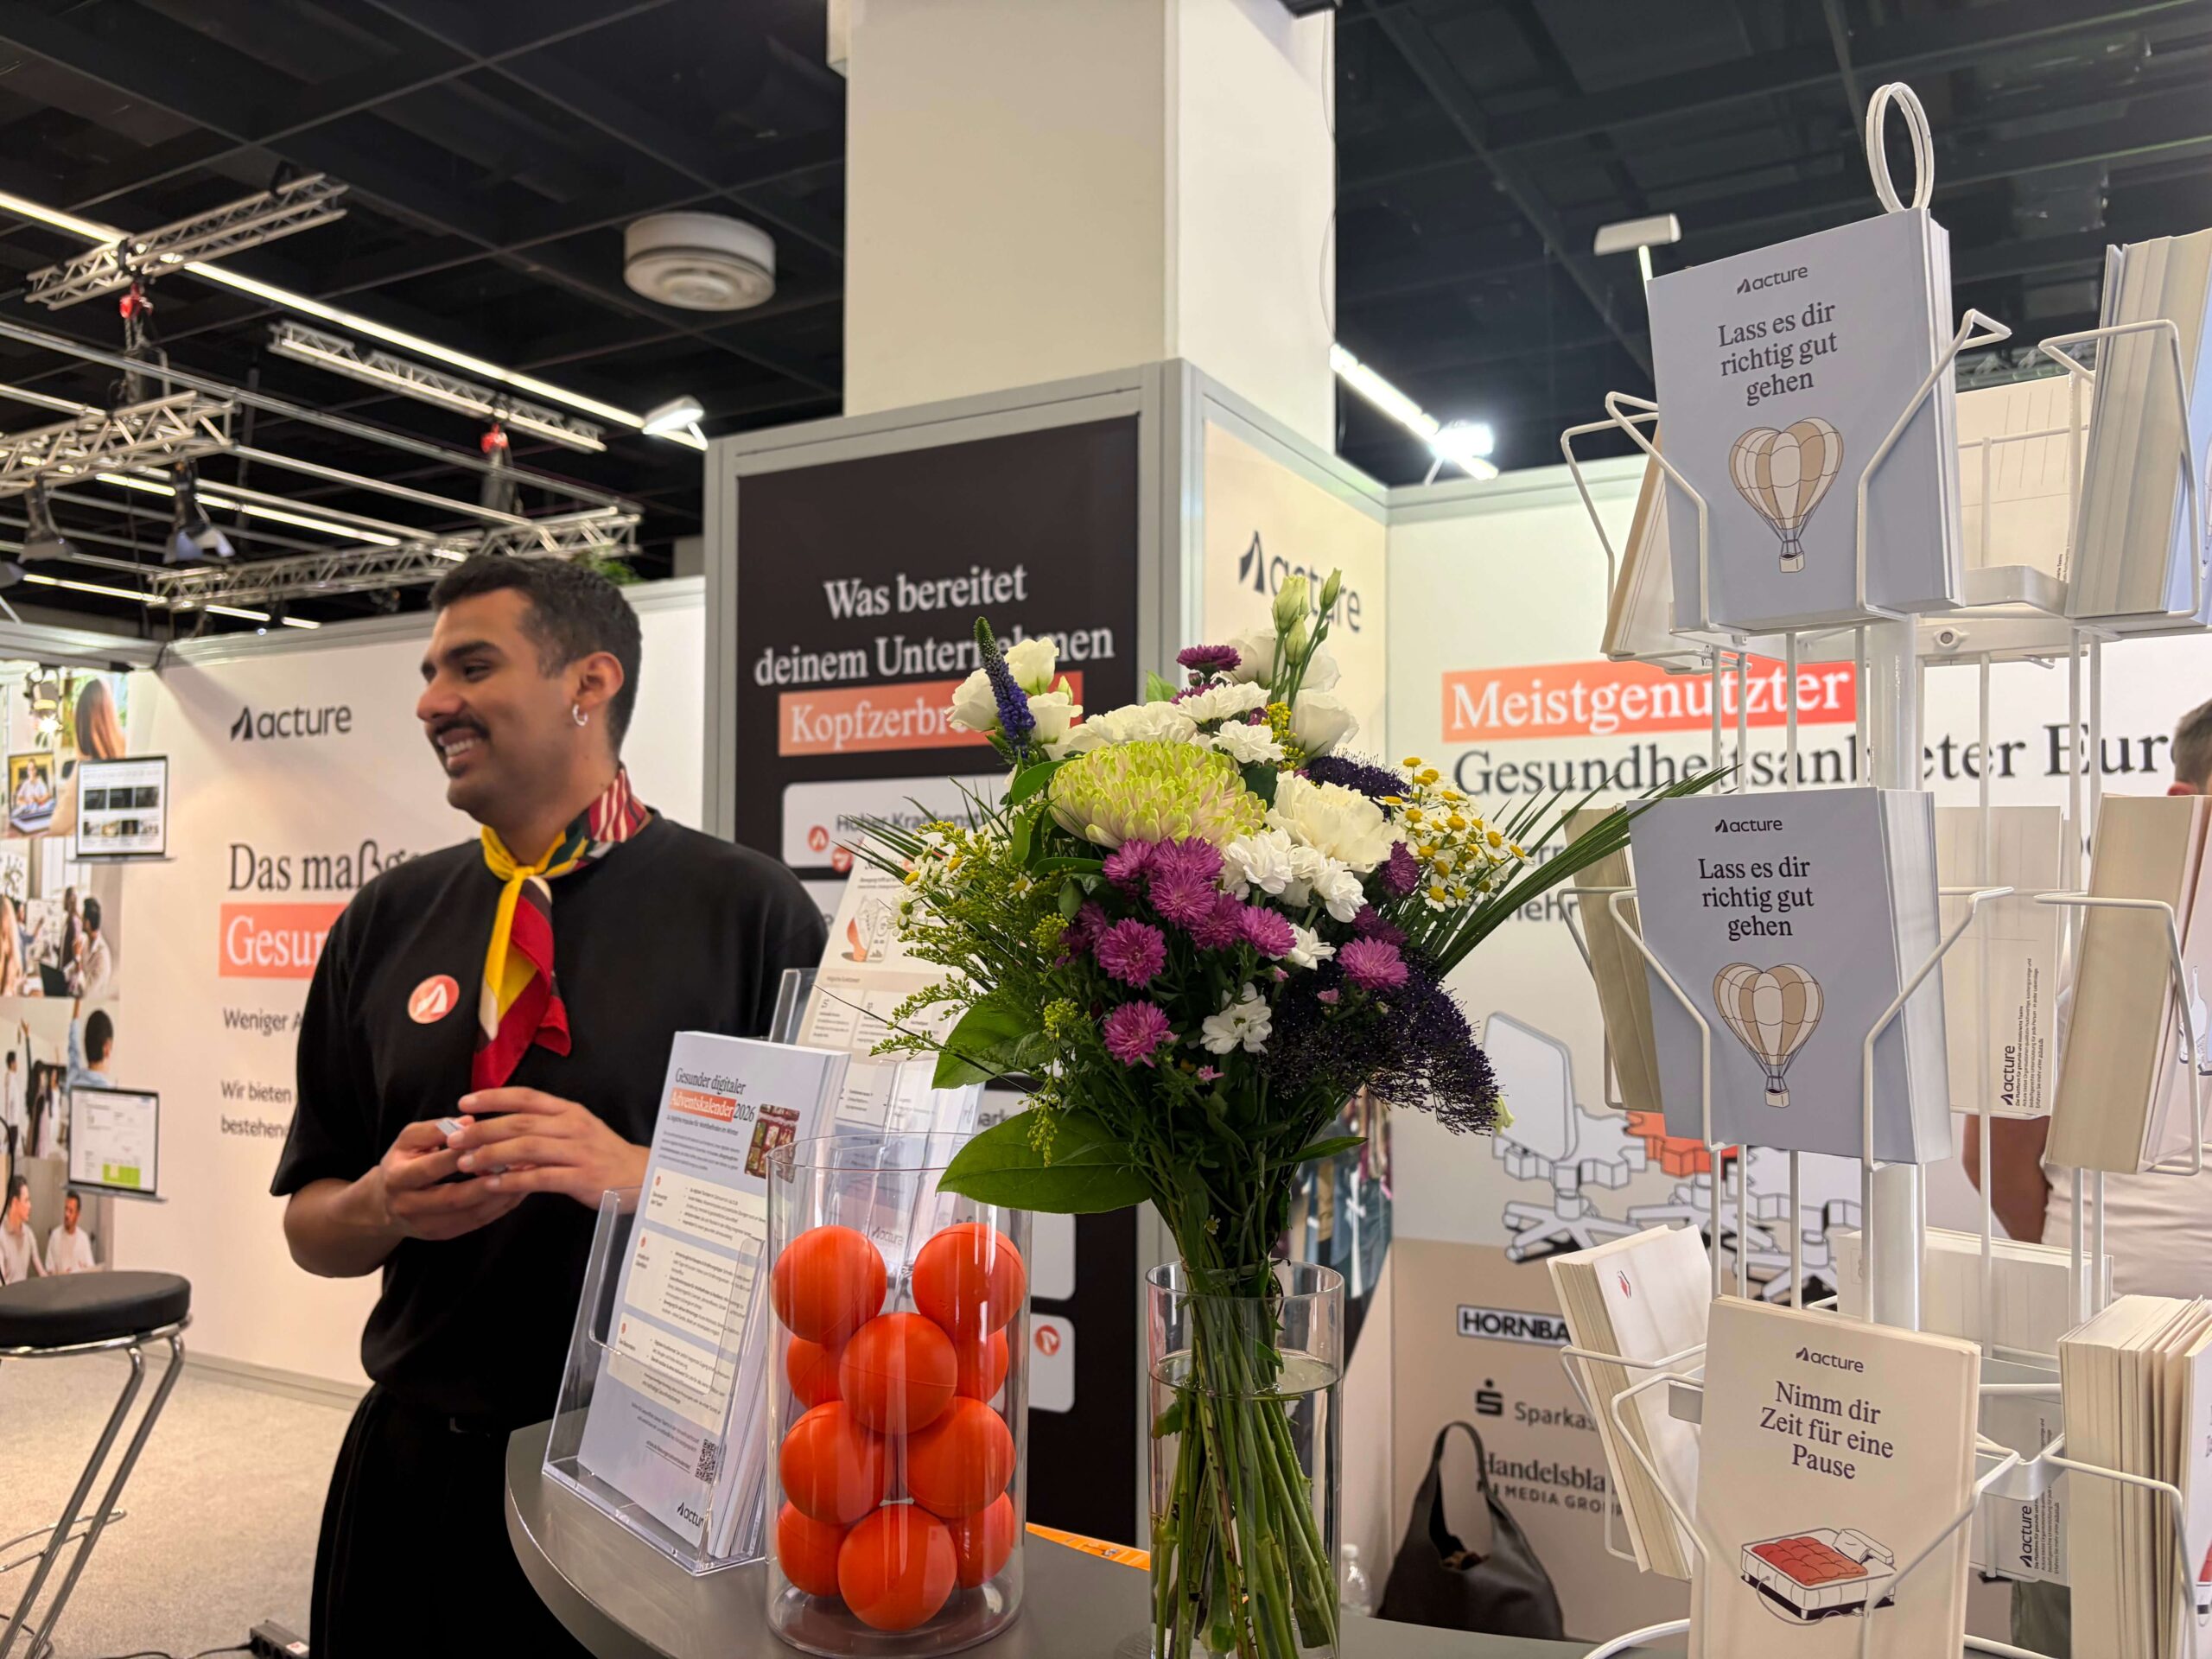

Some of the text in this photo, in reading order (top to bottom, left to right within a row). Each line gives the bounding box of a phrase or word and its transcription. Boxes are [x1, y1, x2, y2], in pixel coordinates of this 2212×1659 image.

[1751, 266, 1808, 291] acture
[1718, 302, 1835, 347] Lass es dir
[1720, 332, 1838, 377] richtig gut
[1746, 371, 1815, 407] gehen
[823, 564, 1029, 620] Was bereitet
[1271, 556, 1361, 632] atre
[754, 624, 1116, 686] deinem Untereen
[1452, 667, 1851, 735] Meistgenutzter
[257, 704, 353, 740] acture
[791, 698, 967, 751] Kopfzerbr
[2043, 722, 2176, 777] Eur
[1729, 819, 1783, 833] acture
[227, 837, 421, 893] Das maß
[1698, 855, 1811, 880] Lass es dir
[1702, 887, 1815, 913] richtig gut
[1727, 914, 1794, 942] gehen
[223, 1007, 289, 1037] Weniger
[676, 1067, 747, 1096] Gesunder digitaler
[2003, 1046, 2016, 1093] acture
[221, 1080, 292, 1105] Wir bieten
[733, 1103, 756, 1122] 2026
[1810, 1351, 1865, 1373] acture
[1775, 1381, 1882, 1425] Nimm dir
[1759, 1406, 1894, 1459] Zeit für eine
[1485, 1452, 1618, 1494] andelsbla
[1791, 1443, 1856, 1480] Pause
[1504, 1484, 1559, 1505] MEDIA
[2022, 1505, 2032, 1554] acture
